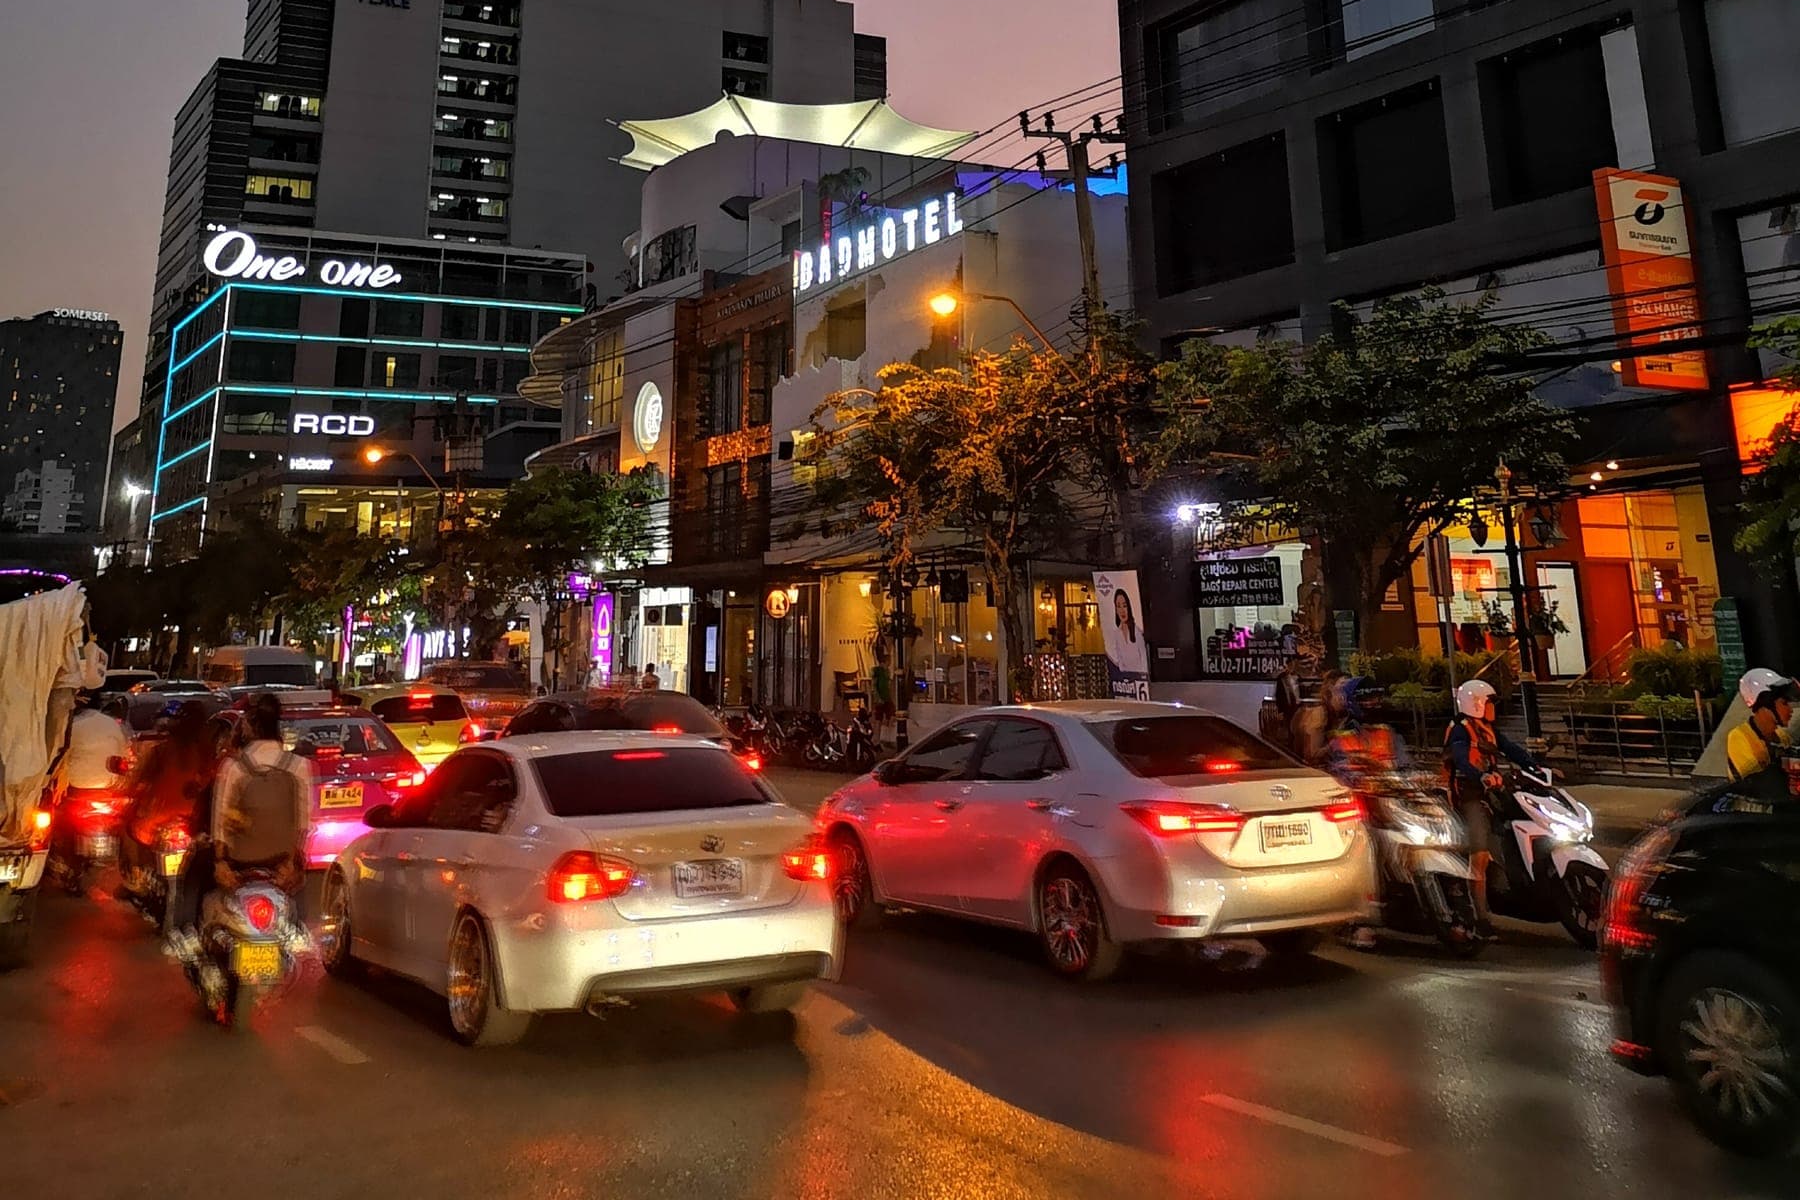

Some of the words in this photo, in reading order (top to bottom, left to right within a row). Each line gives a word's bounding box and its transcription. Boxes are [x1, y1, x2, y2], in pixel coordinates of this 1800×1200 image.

[320, 260, 402, 288] one
[53, 307, 109, 322] SOMERSET
[293, 413, 375, 436] RCD
[1221, 579, 1248, 592] REPAIR
[1248, 578, 1280, 589] CENTER
